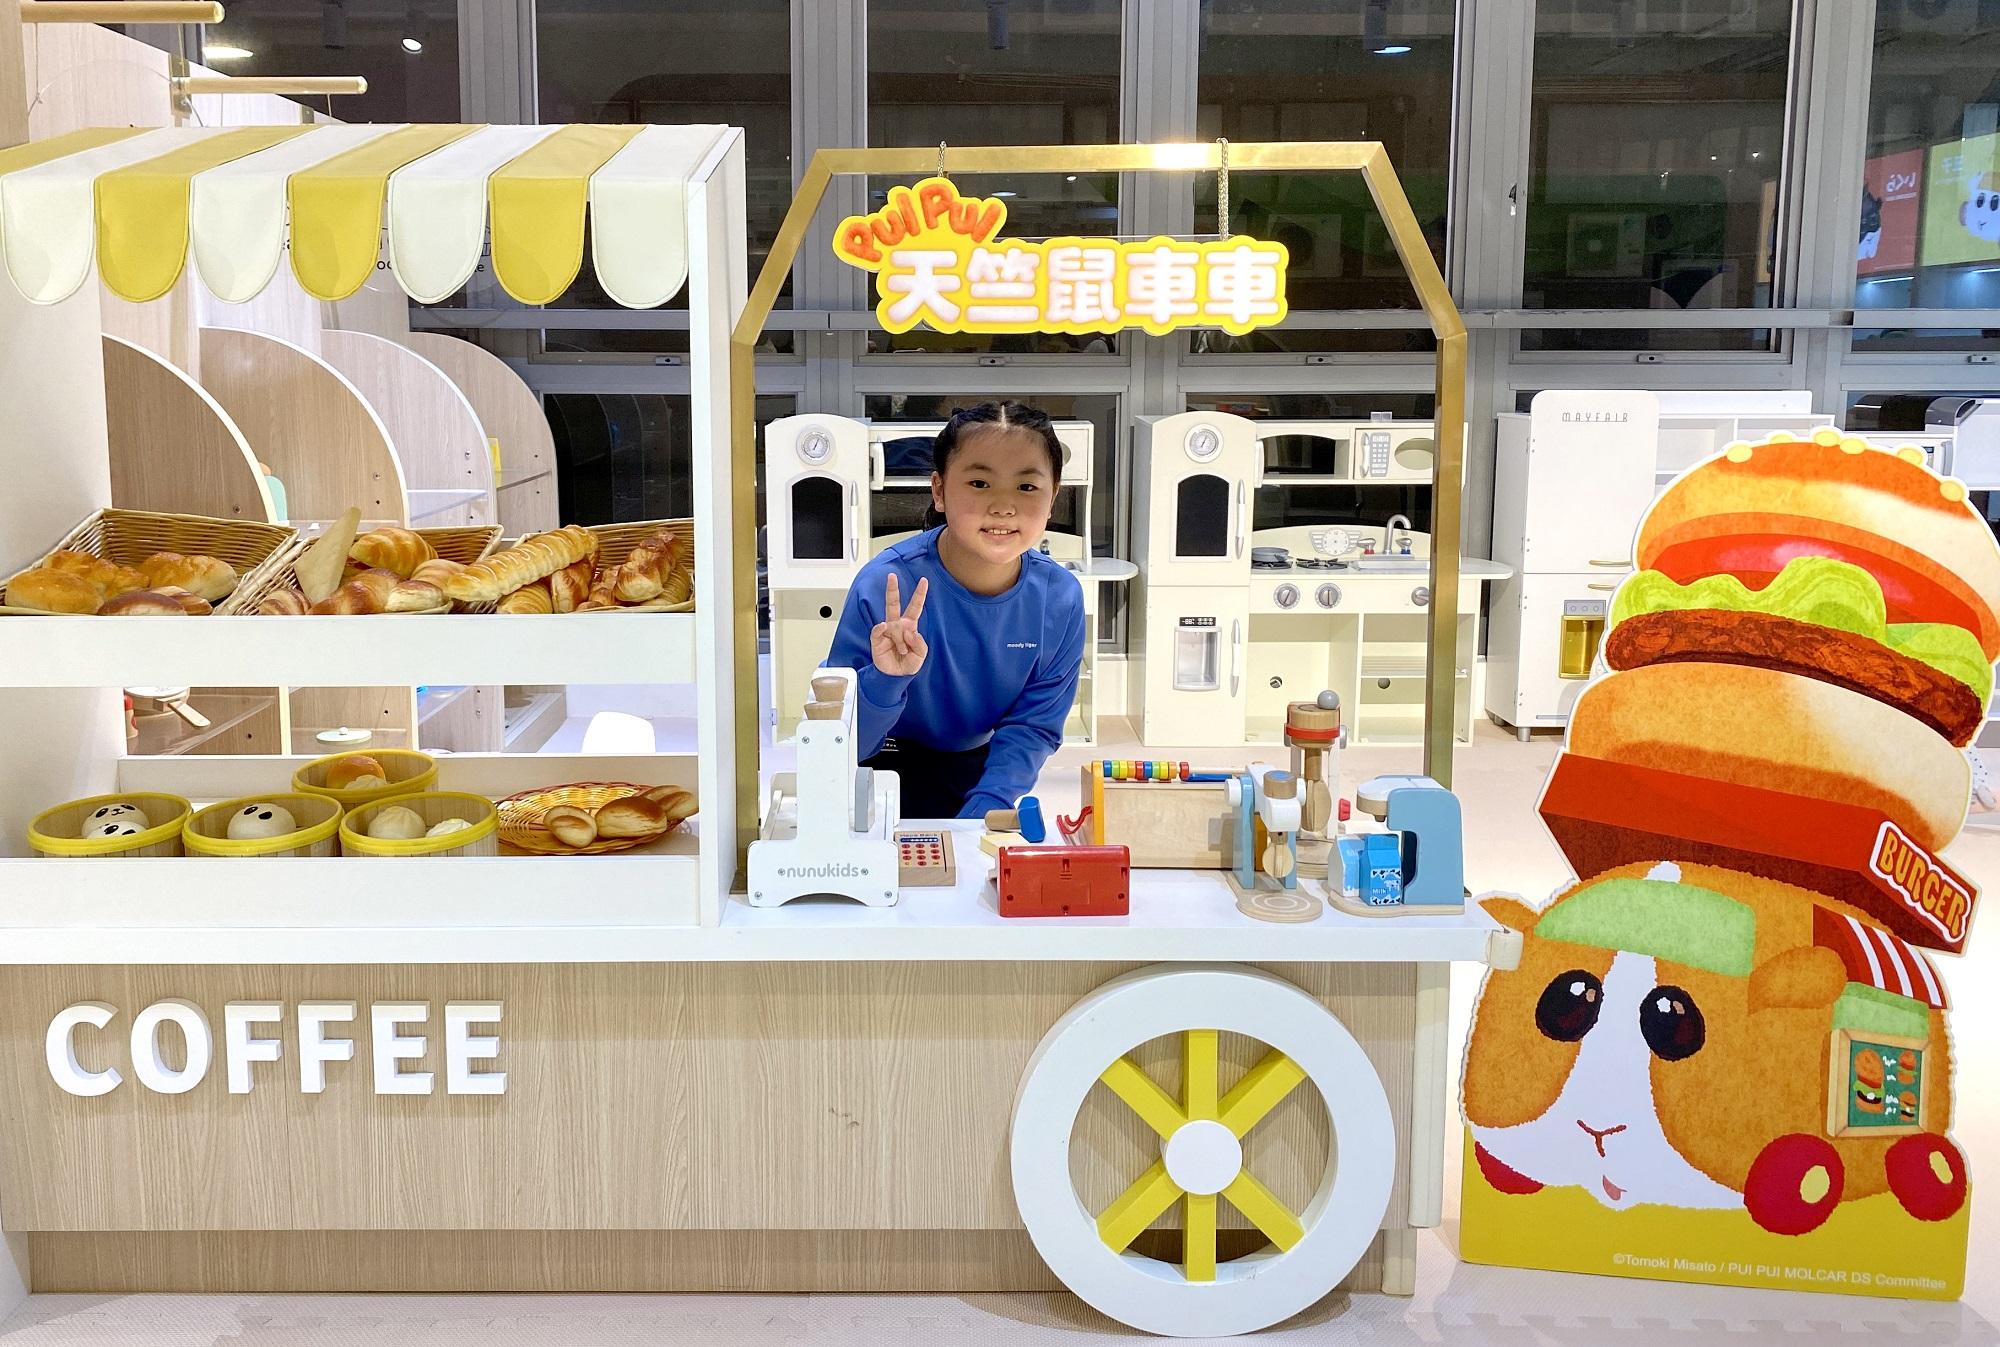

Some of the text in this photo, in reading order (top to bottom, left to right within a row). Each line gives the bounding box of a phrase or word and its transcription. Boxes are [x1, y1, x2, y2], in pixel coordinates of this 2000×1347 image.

[887, 245, 1281, 324] 天竺鼠車車
[1561, 412, 1628, 423] MAYFAIR
[786, 863, 859, 878] nunukids
[1879, 830, 1965, 937] BURGER
[45, 998, 508, 1097] COFFEE
[1673, 1258, 1716, 1273] Misato
[1728, 1262, 1752, 1276] PUI
[1756, 1264, 1780, 1278] PUI
[1785, 1267, 1847, 1282] MOLCAR
[1851, 1272, 1871, 1285] DS
[1876, 1274, 1947, 1290] Committee
